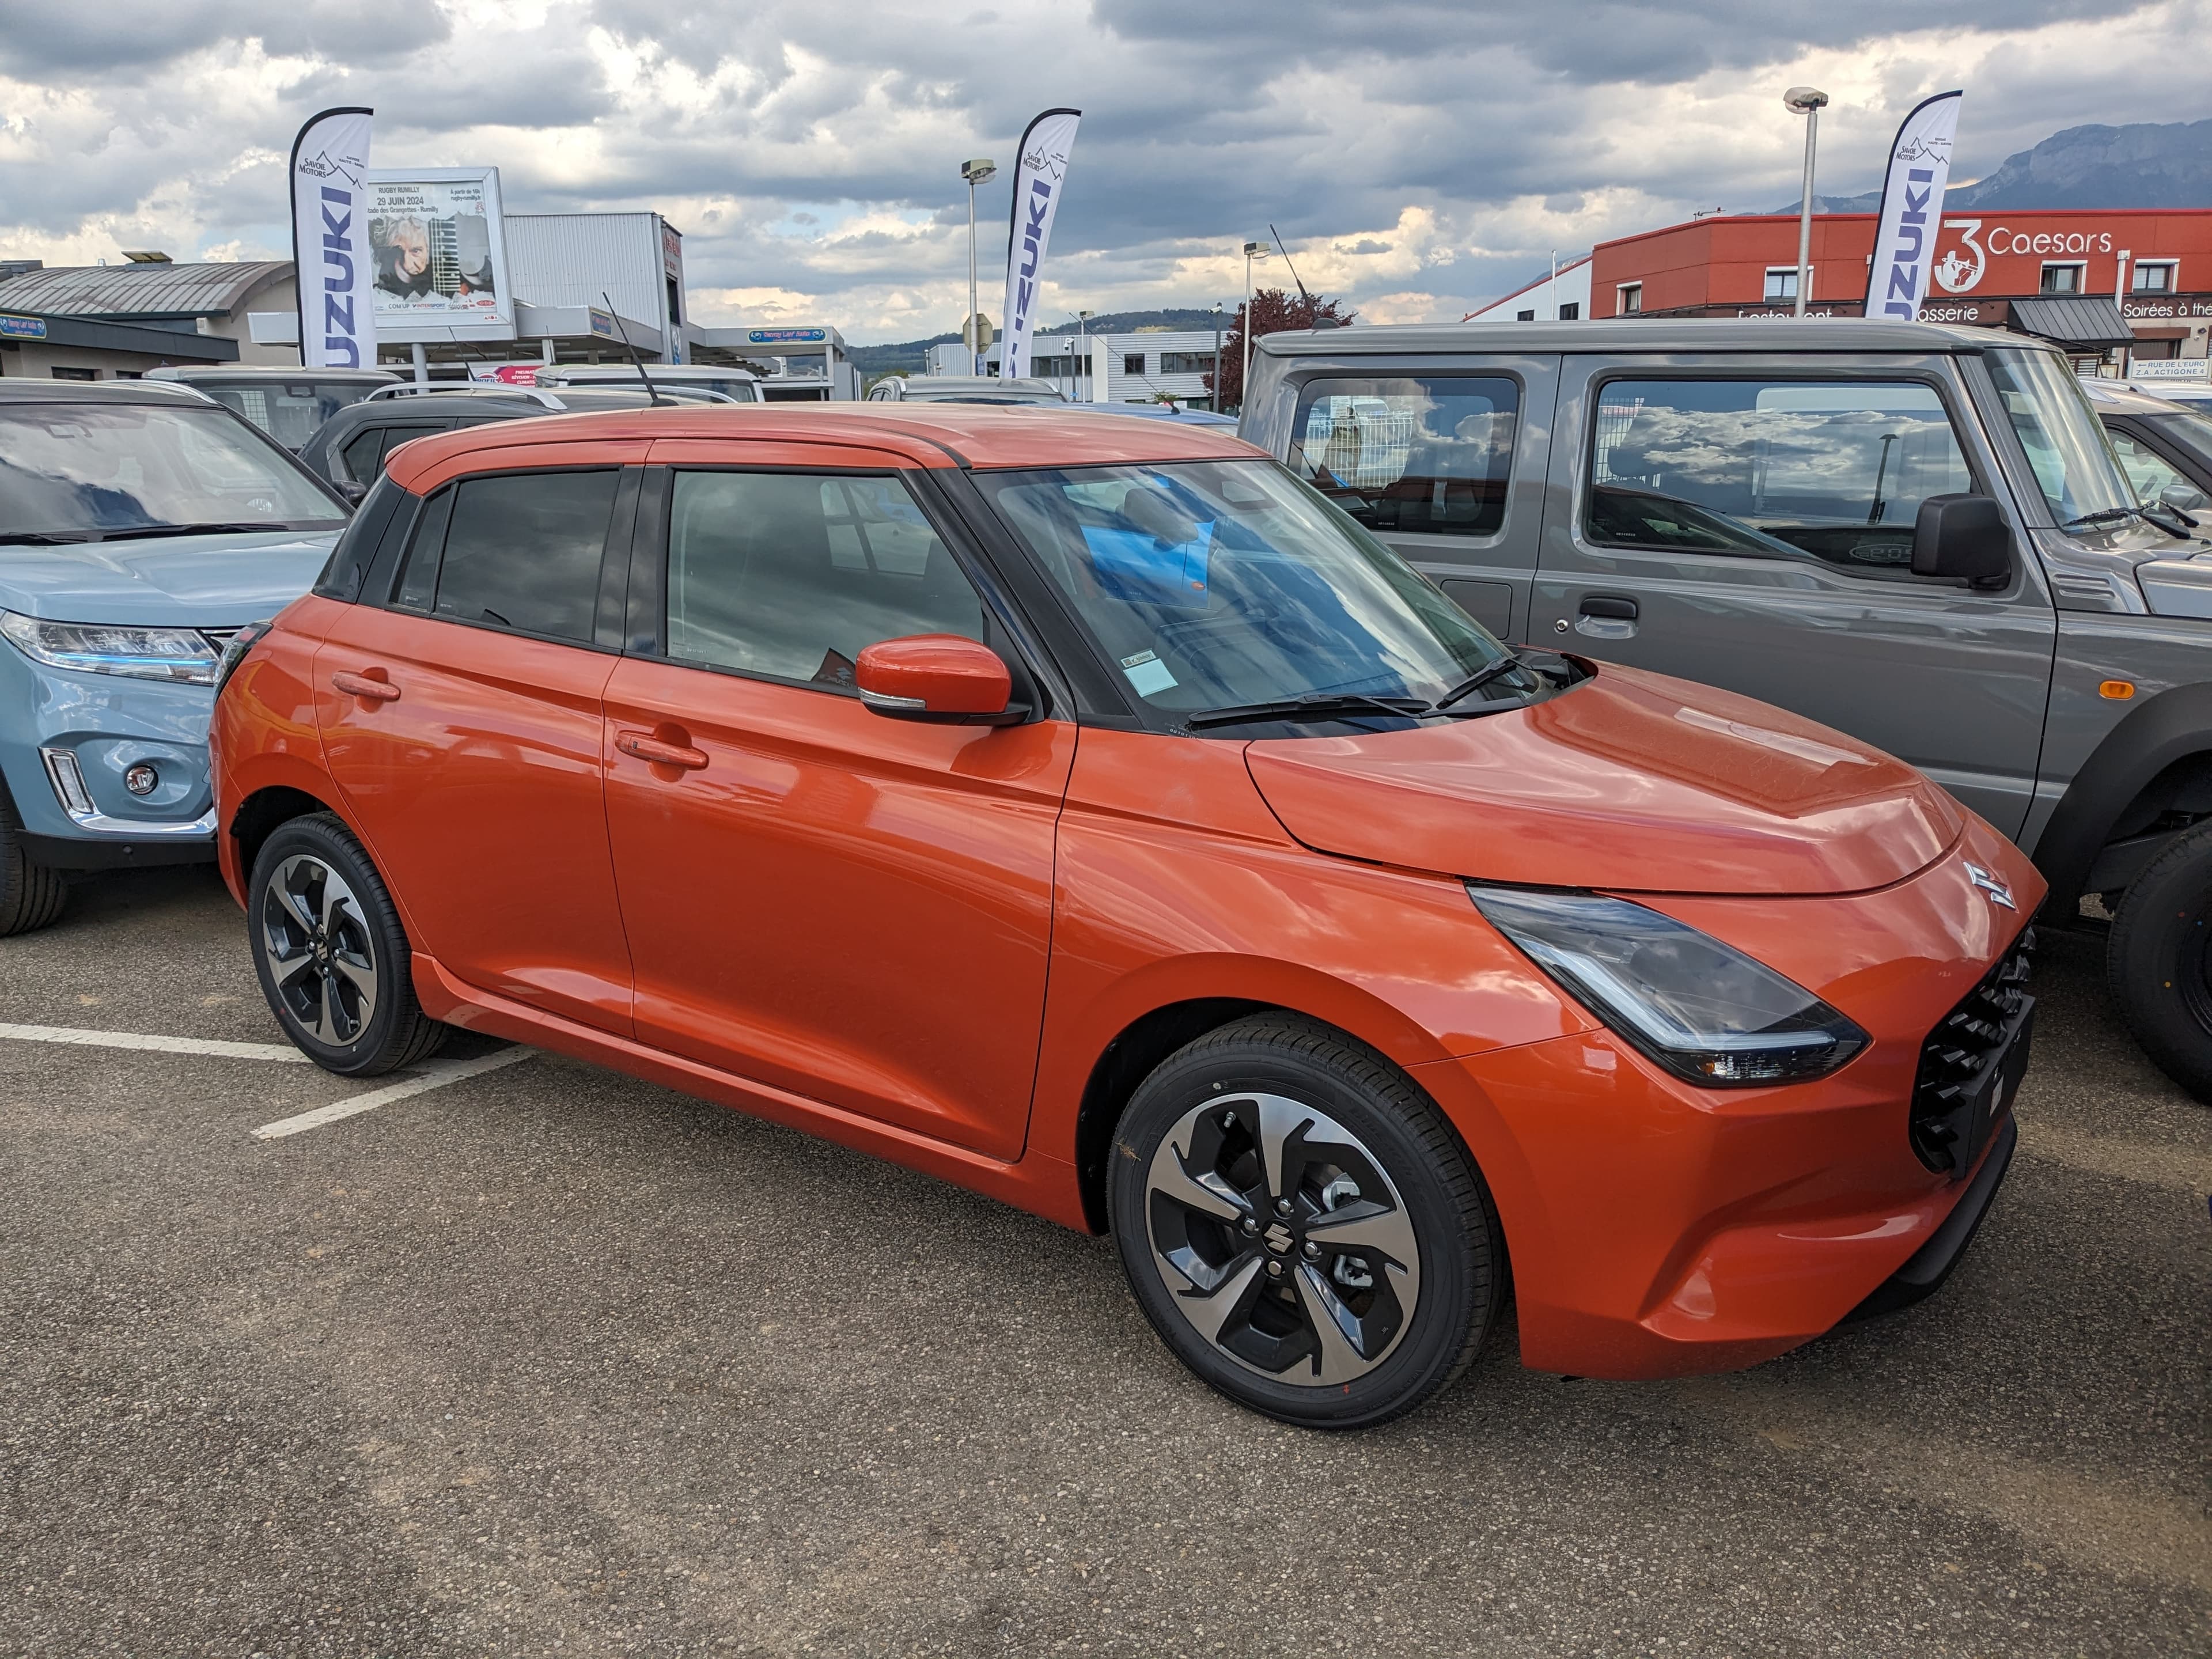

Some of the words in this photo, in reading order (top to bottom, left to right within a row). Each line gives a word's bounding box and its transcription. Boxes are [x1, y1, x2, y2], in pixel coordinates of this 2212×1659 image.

[1902, 145, 1916, 154] SAVOIE
[1028, 152, 1041, 165] SAVOIE
[1896, 152, 1916, 161] MOTORS
[298, 164, 327, 178] MOTORS
[304, 158, 326, 171] SAVOIE
[1023, 157, 1040, 172] MOTORS
[377, 197, 386, 206] 29
[388, 196, 405, 206] JUIN
[406, 196, 424, 205] 2024
[389, 206, 417, 215] Grangettes
[420, 206, 438, 214] Rumilly
[1934, 219, 1986, 294] 3
[1987, 226, 2112, 255] Caesars
[2123, 303, 2173, 317] Soirées
[2178, 302, 2187, 316] à
